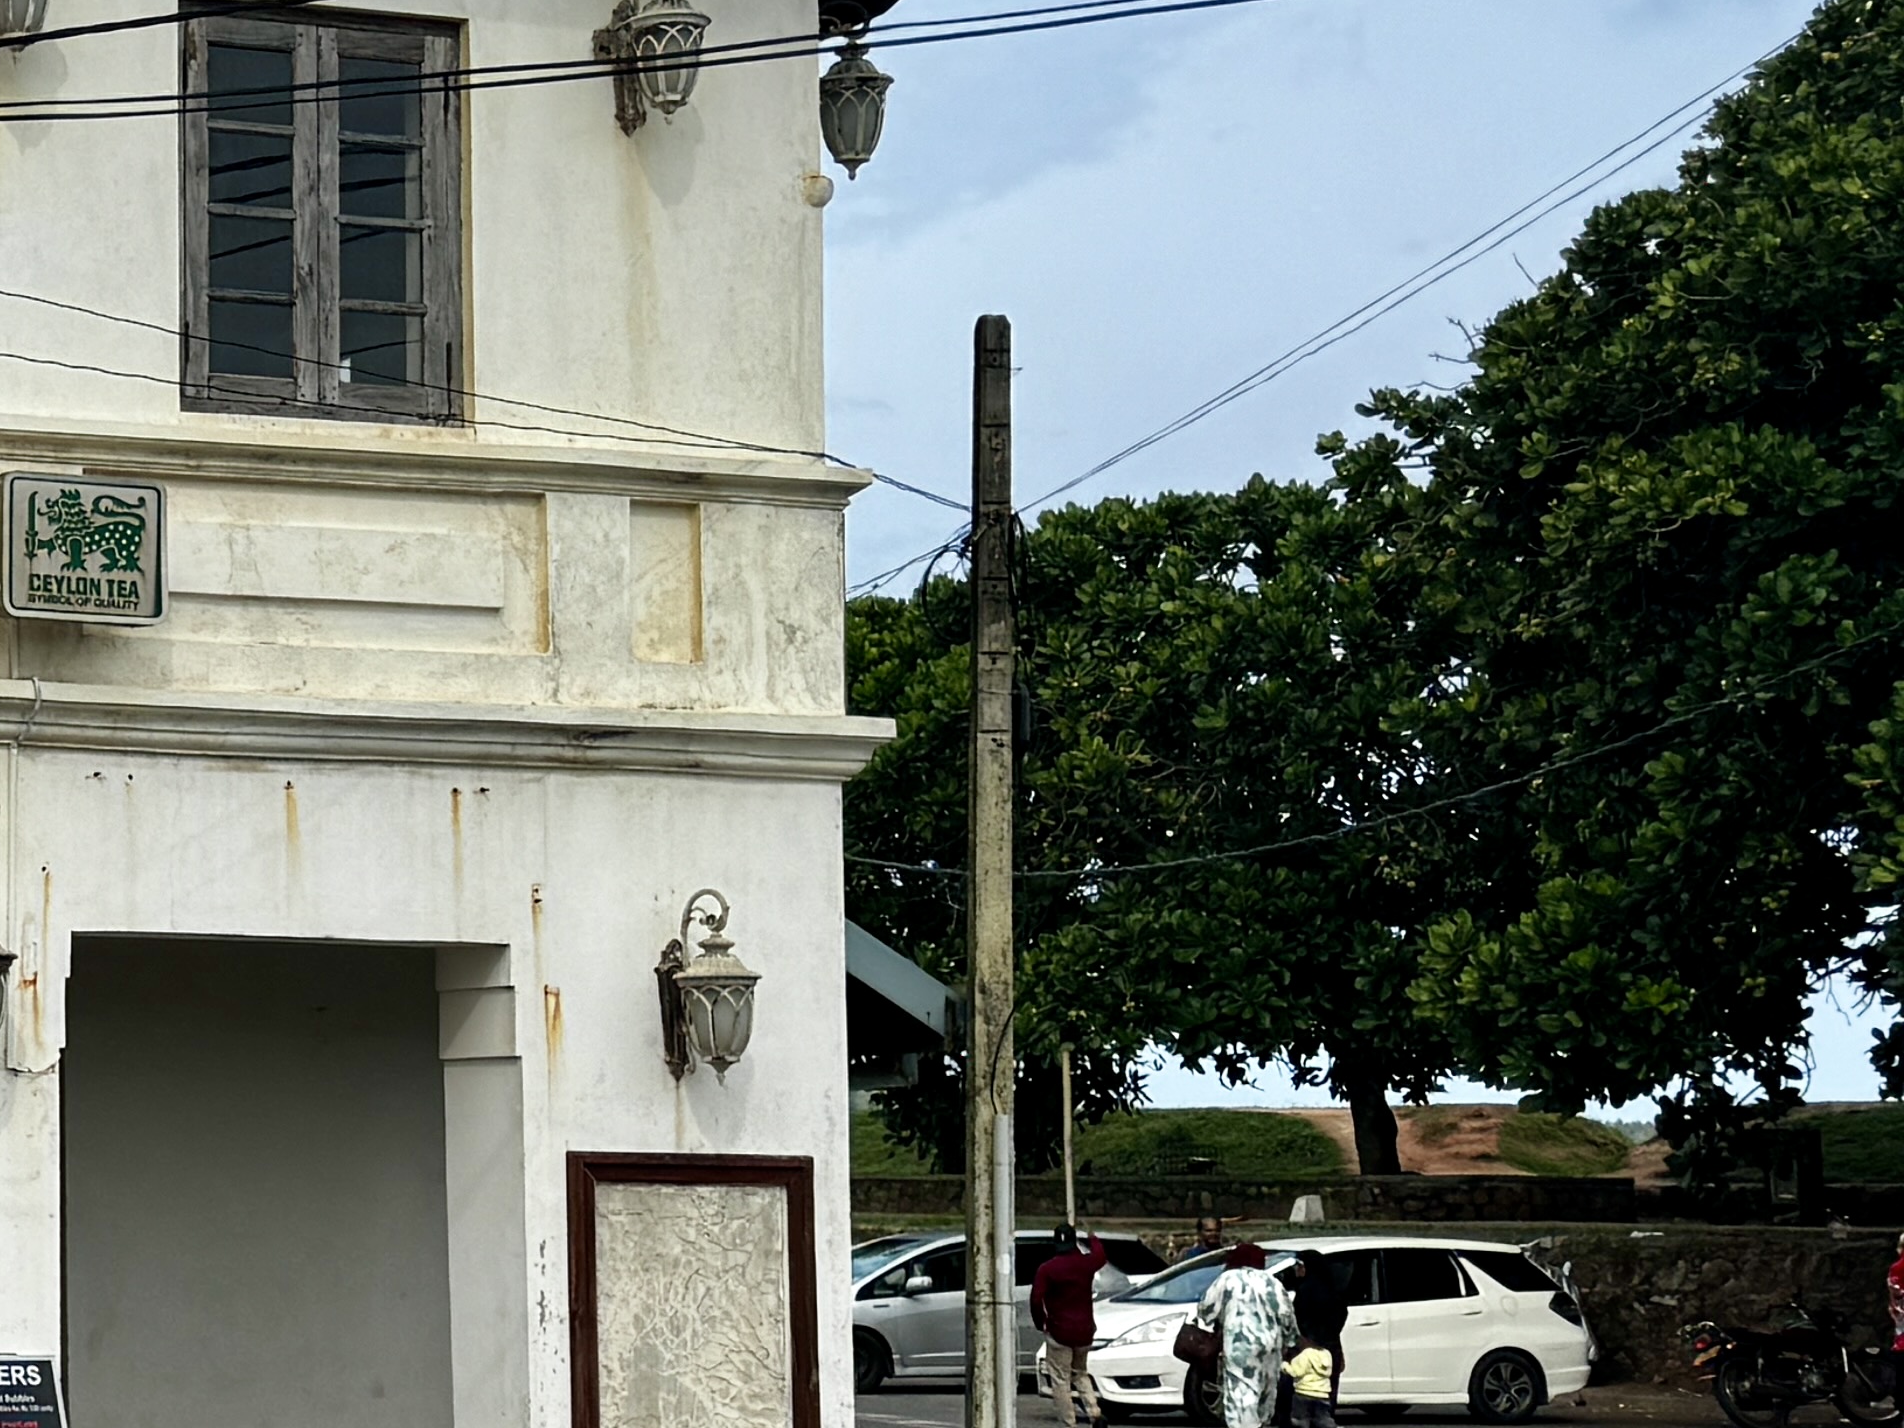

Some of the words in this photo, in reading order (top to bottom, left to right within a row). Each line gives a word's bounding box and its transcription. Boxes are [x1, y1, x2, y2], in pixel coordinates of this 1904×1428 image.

[29, 573, 101, 597] CEYLON
[106, 579, 140, 599] TEA
[76, 595, 91, 607] OF
[94, 597, 139, 611] QUALITY
